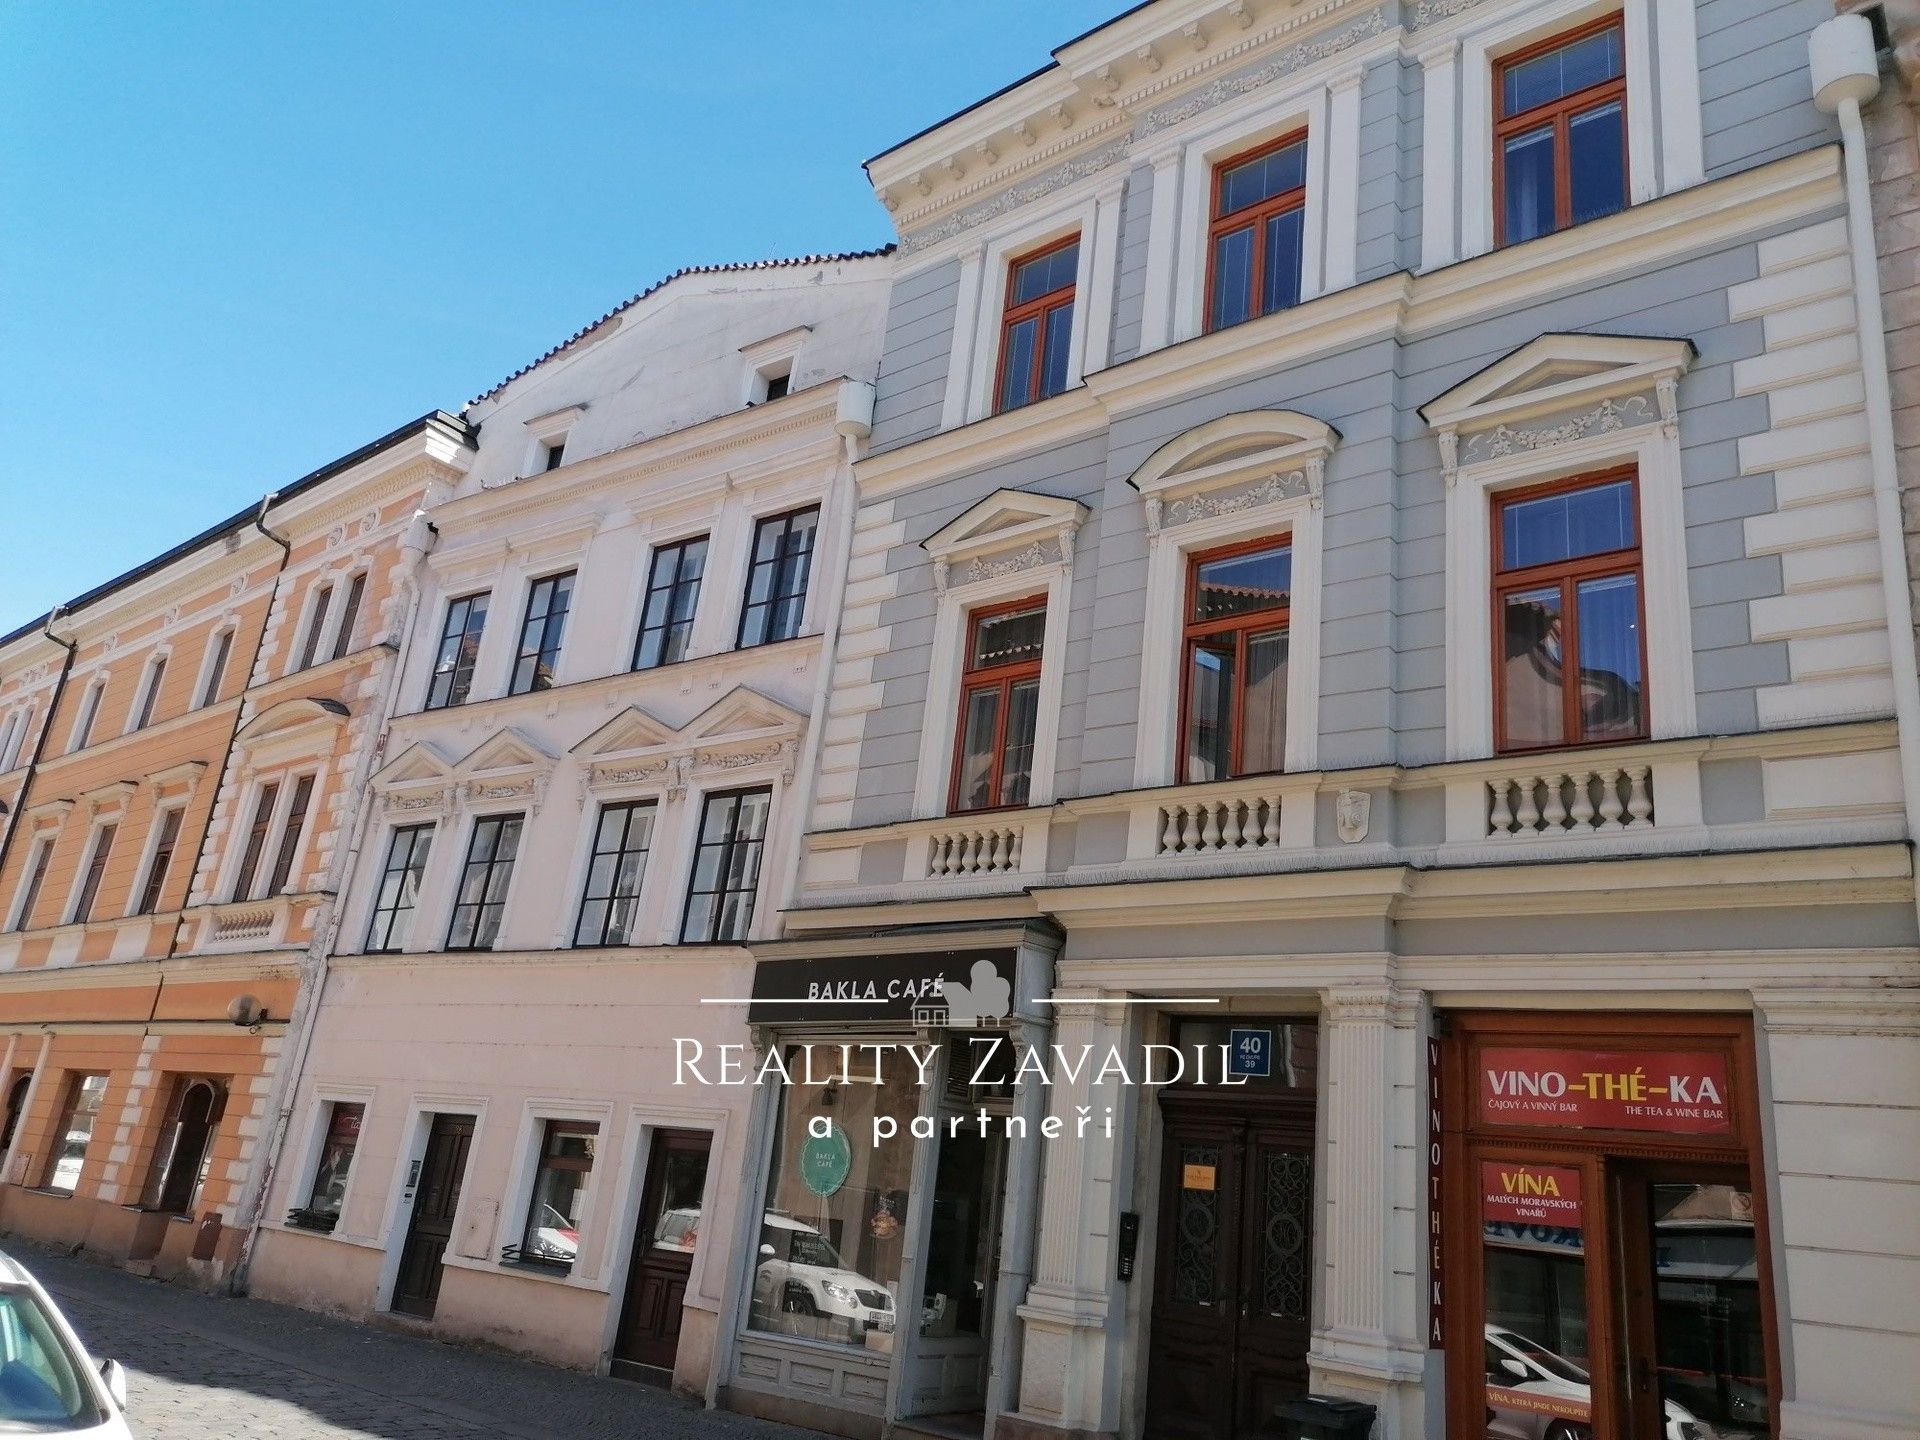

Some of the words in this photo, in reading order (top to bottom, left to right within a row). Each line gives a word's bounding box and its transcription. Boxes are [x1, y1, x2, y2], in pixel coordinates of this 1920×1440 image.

[808, 981, 877, 1001] BAKLA
[887, 973, 945, 999] CAFÉ
[1240, 1037, 1261, 1053] 40
[1245, 1060, 1255, 1068] 39
[1522, 1101, 1529, 1109] A
[1530, 1102, 1558, 1112] VINNÝ
[1560, 1104, 1577, 1112] BAR
[1625, 1106, 1643, 1115] THE
[1645, 1107, 1664, 1116] TEA
[1666, 1108, 1673, 1117] &
[1675, 1109, 1701, 1117] WINE
[1704, 1110, 1723, 1119] BAR
[1501, 1167, 1560, 1197] VÍNA
[1487, 1195, 1518, 1204] MALÝCH
[1520, 1198, 1577, 1210] MORAVSKÝCH
